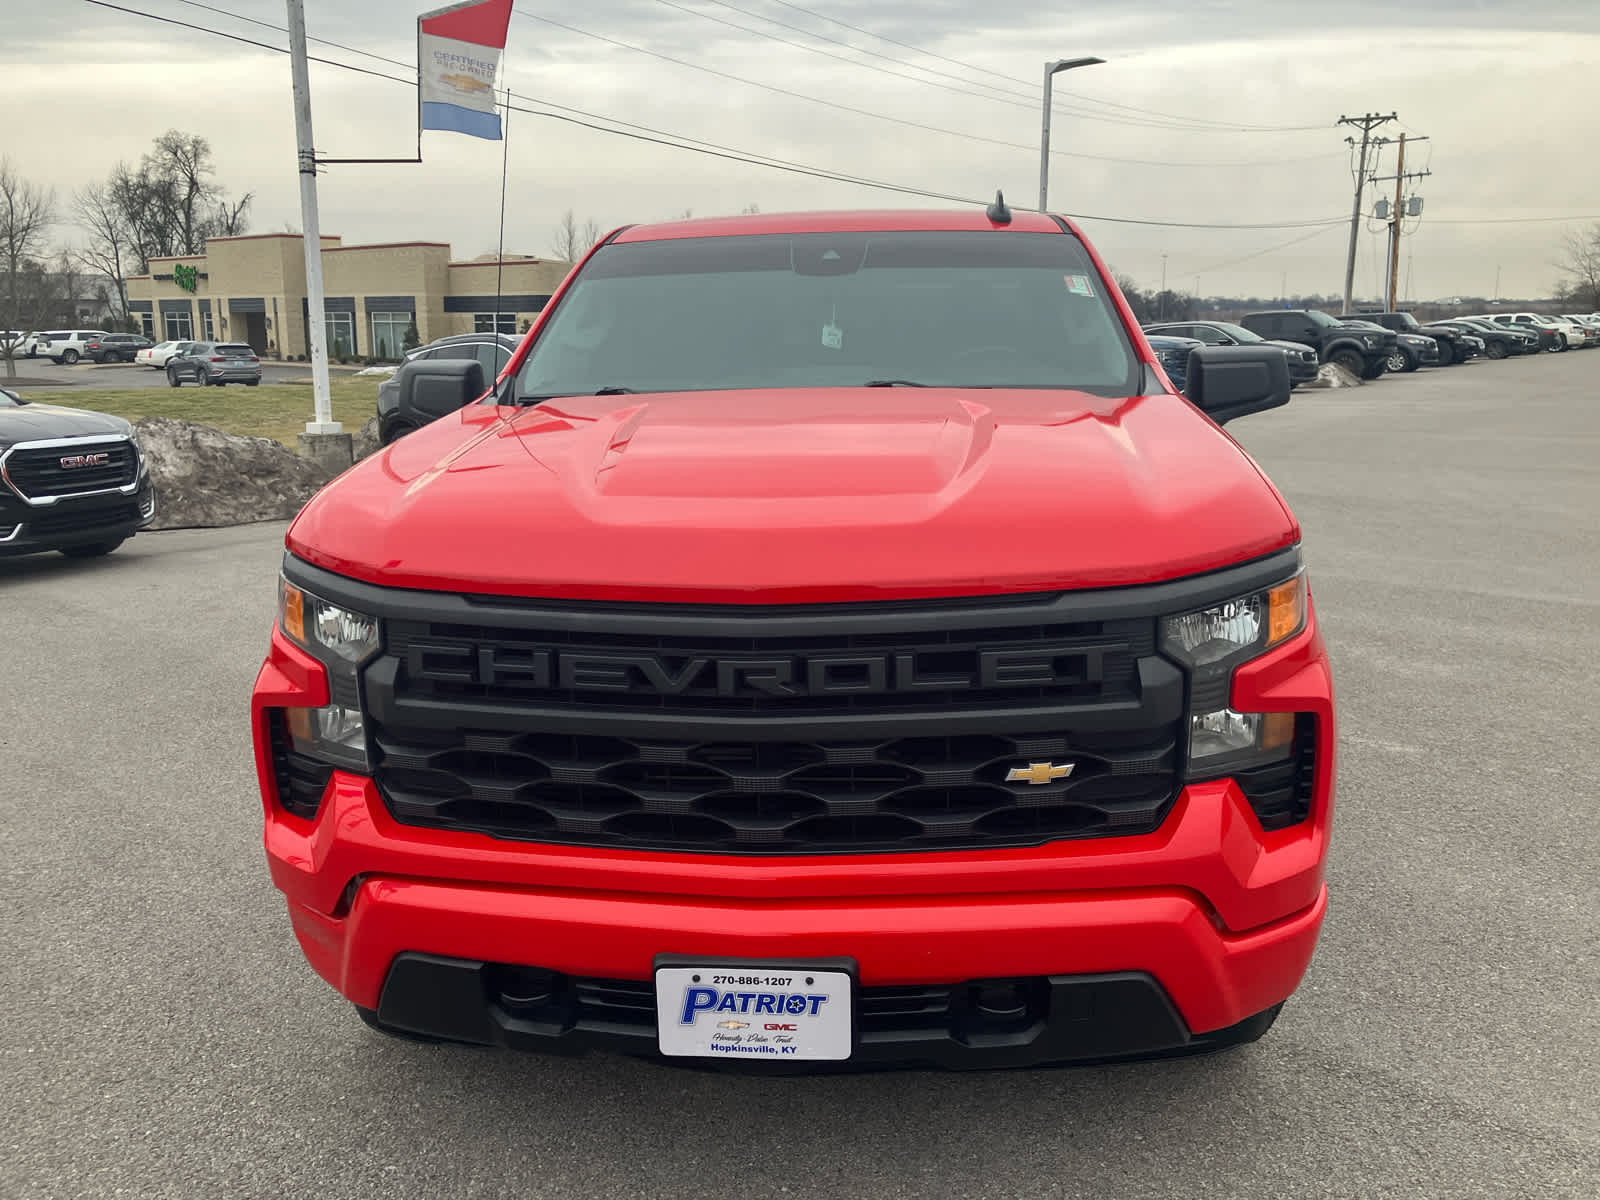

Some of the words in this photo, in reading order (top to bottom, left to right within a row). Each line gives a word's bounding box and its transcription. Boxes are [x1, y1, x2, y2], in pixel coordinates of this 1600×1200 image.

[60, 453, 109, 468] GMC
[406, 640, 1129, 698] CHEVROLET
[713, 976, 793, 986] 270-886-1207
[680, 985, 829, 1025] PATRIOT
[764, 1023, 798, 1031] GMC
[711, 1043, 778, 1054] Hopkinsville,
[781, 1046, 797, 1054] KY
